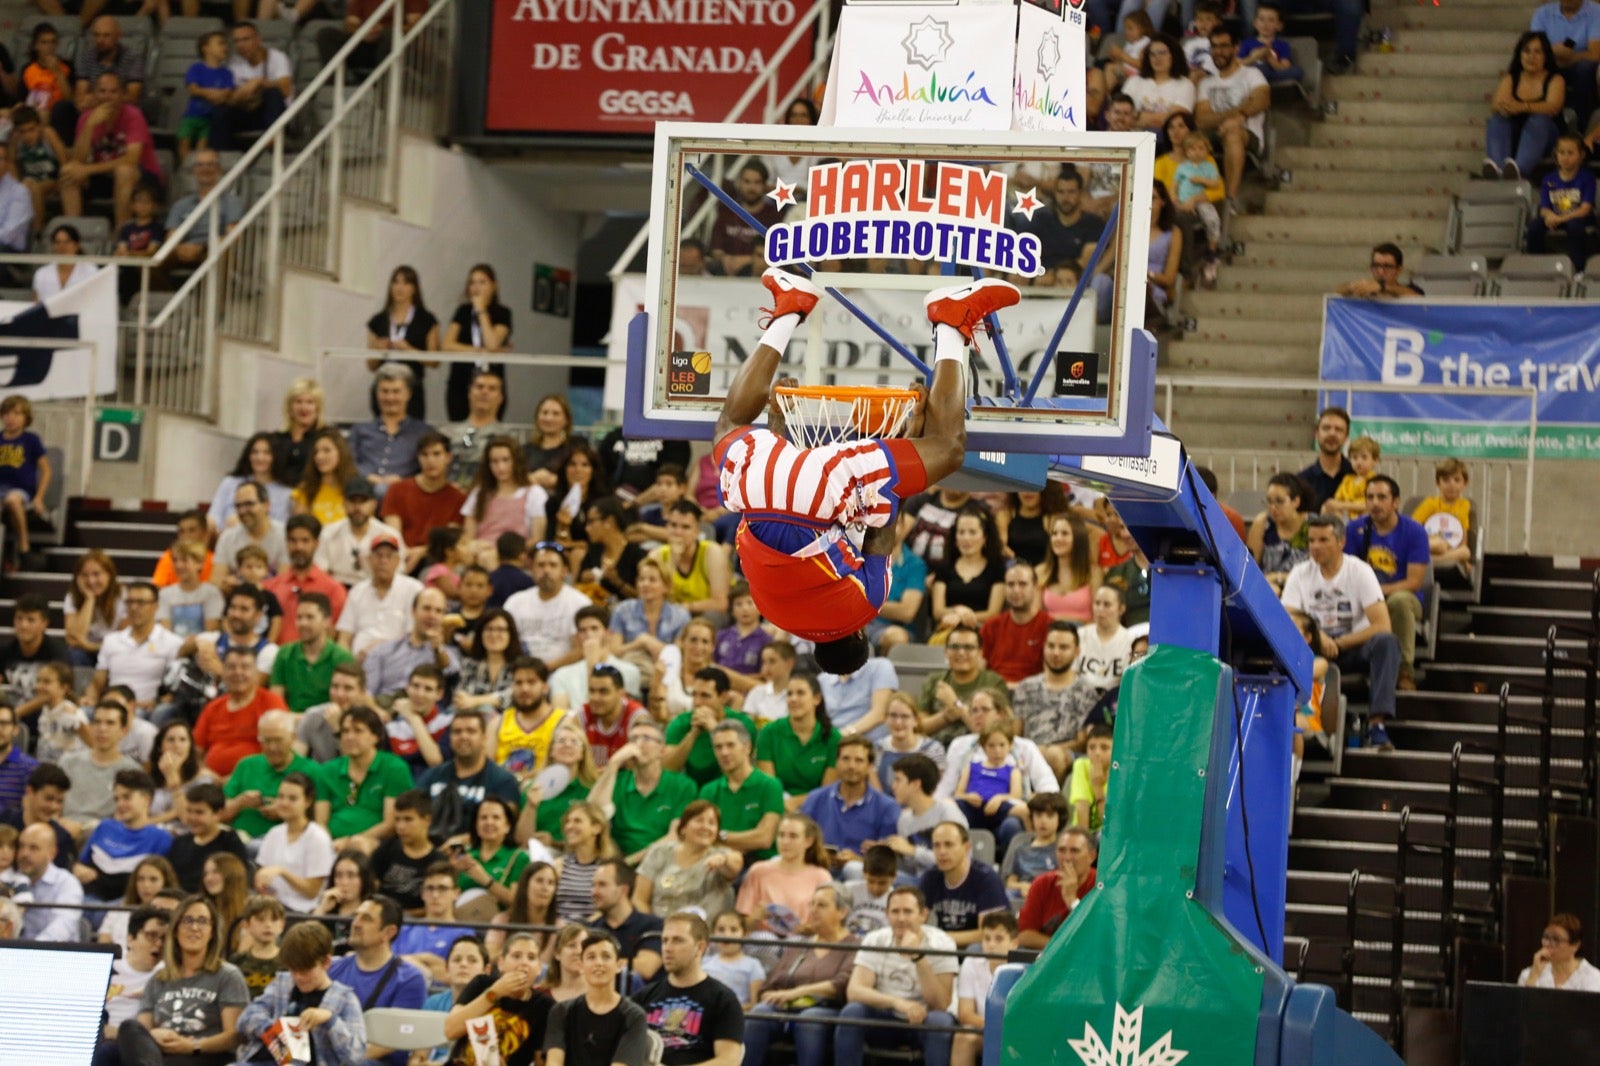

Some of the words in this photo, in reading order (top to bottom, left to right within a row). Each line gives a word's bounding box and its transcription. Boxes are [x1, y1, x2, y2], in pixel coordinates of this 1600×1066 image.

[511, 0, 796, 25] AYUNTAMIENTO
[532, 43, 582, 70] DE
[591, 32, 768, 73] GRANADA
[852, 70, 998, 107] Andalucía
[1016, 72, 1077, 128] Andalucía
[808, 161, 1005, 226] HARLEM
[767, 218, 1038, 275] GLOBETROTTERS
[671, 371, 696, 383] LEB
[672, 356, 688, 367] Liga
[1382, 328, 1426, 385] B
[1439, 352, 1511, 388] the
[671, 382, 694, 392] ORO
[100, 422, 131, 460] D
